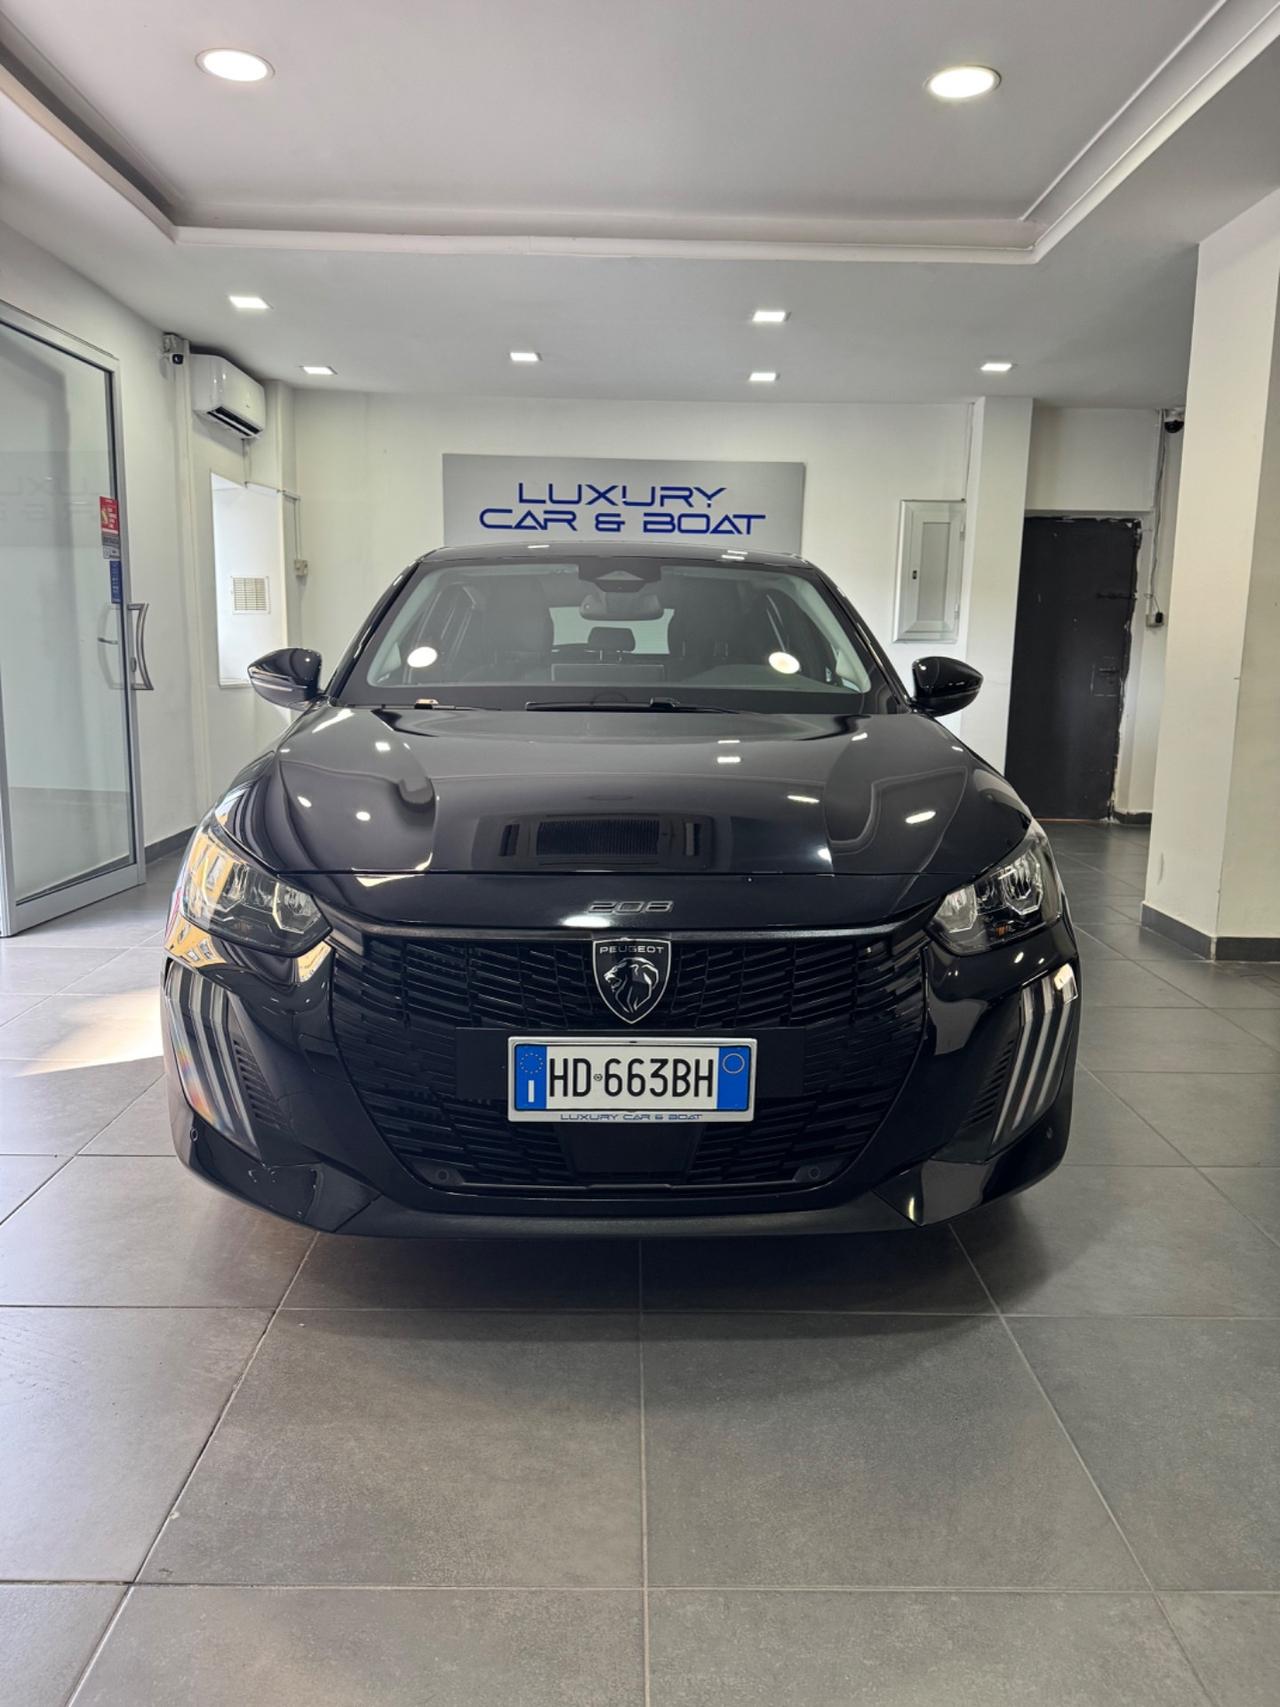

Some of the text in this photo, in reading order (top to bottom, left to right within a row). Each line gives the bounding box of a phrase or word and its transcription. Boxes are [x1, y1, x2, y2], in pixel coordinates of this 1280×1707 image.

[518, 482, 727, 508] LUXURY
[479, 508, 767, 536] CAR & BOAT
[587, 900, 673, 915] 208
[599, 945, 665, 954] PEUGEOT
[560, 1113, 618, 1121] LUXURY
[622, 1113, 651, 1121] CAR
[668, 1113, 703, 1121] BOAT
